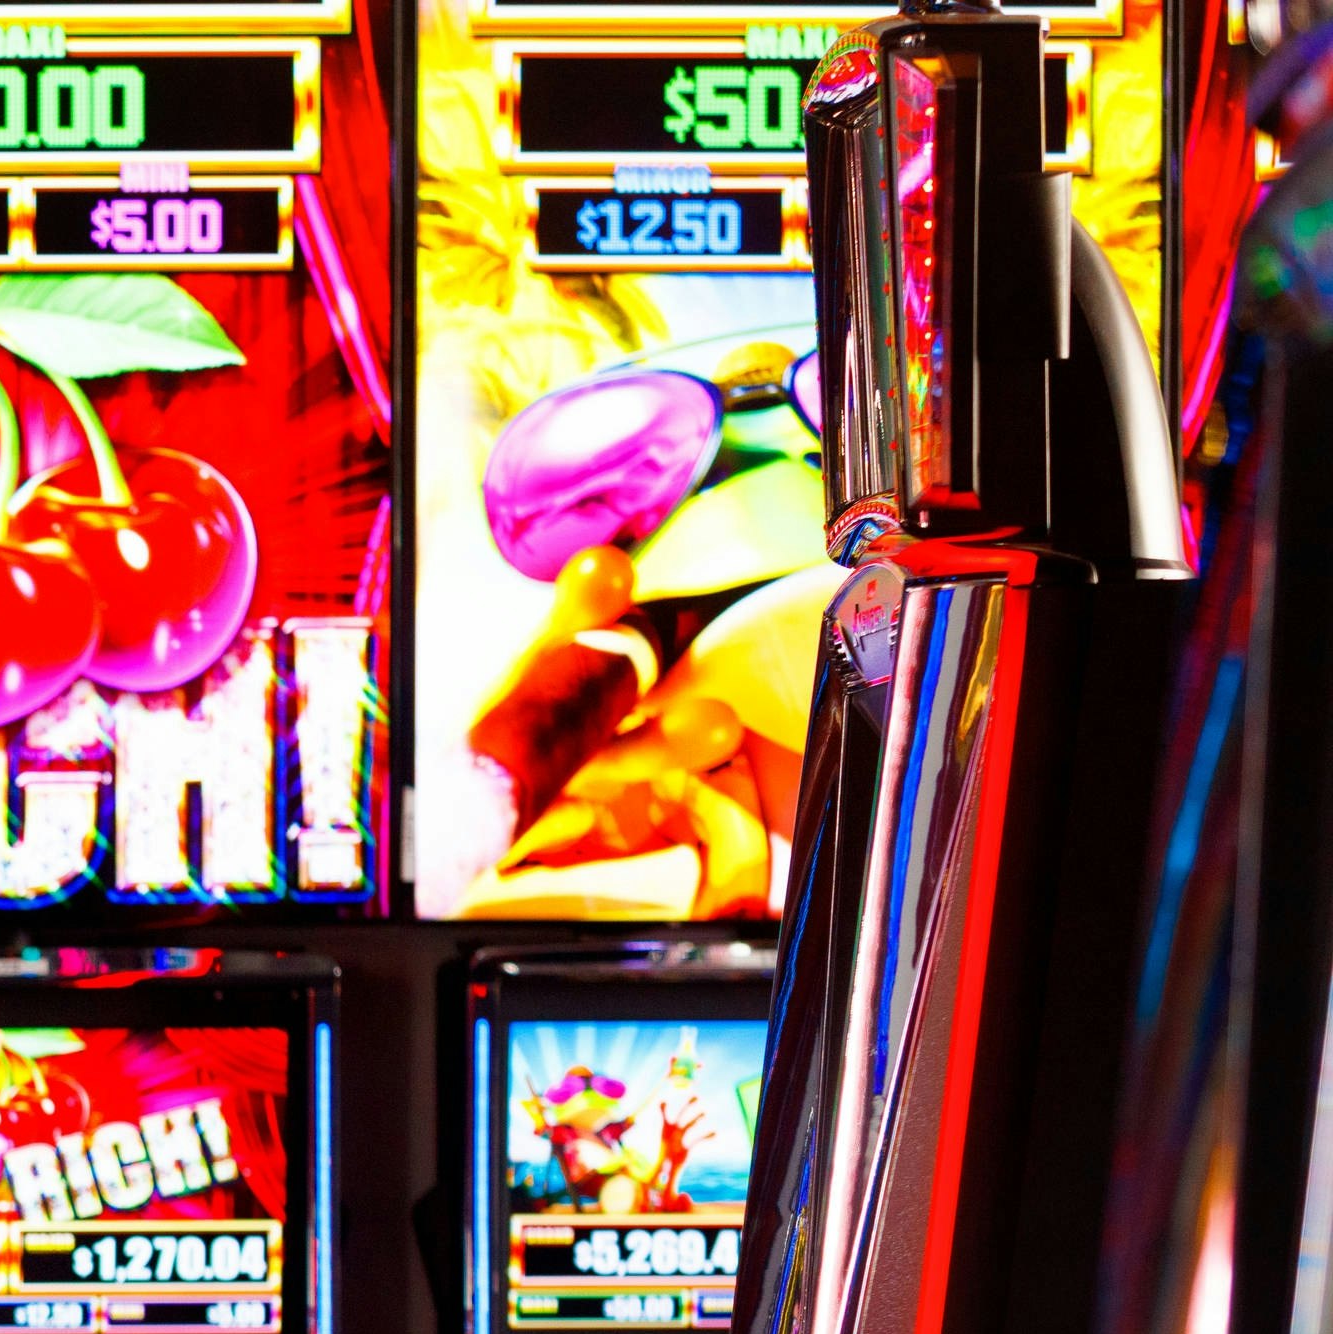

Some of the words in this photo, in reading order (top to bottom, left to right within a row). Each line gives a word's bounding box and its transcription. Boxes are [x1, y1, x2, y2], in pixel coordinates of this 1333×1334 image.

[663, 66, 805, 148] $50.
[90, 200, 223, 253] $5.00
[576, 200, 741, 254] $12.50
[4, 1098, 238, 1222] RICH!
[574, 1229, 744, 1276] $5,269.4
